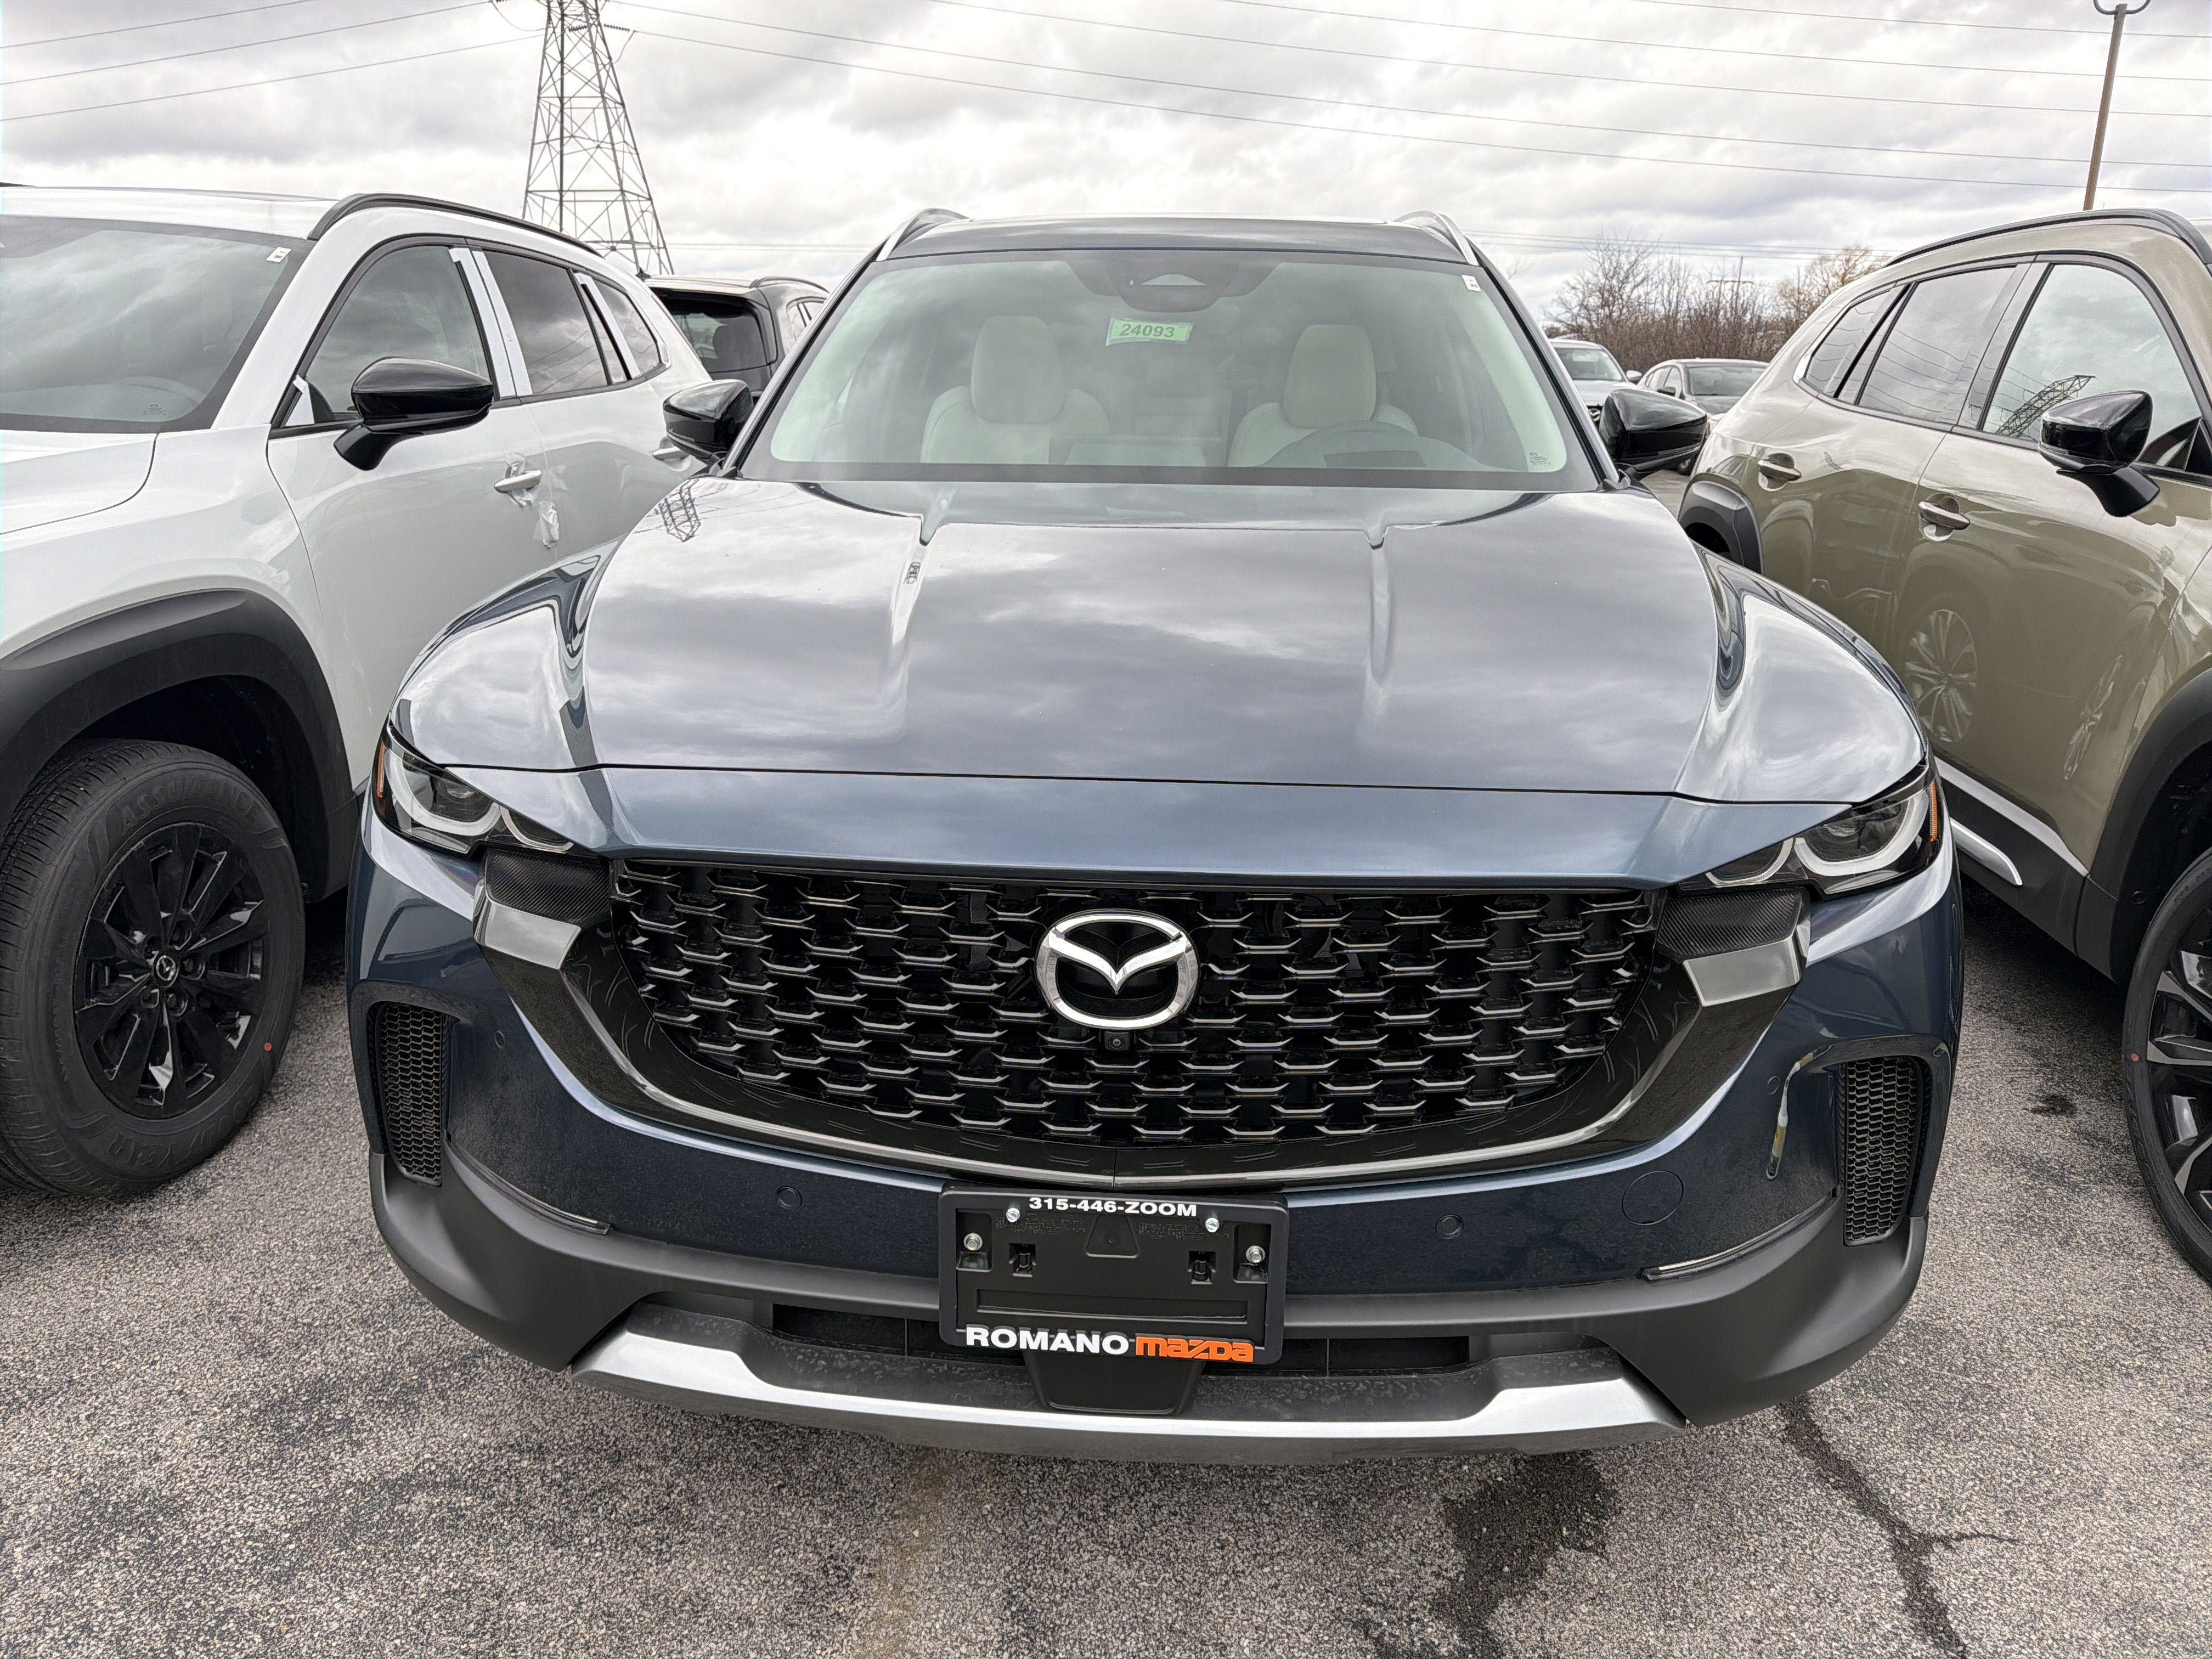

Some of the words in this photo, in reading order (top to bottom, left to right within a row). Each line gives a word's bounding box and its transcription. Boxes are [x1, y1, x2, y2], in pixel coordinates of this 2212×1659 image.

[1119, 324, 1175, 338] 24093
[1029, 1197, 1197, 1217] 315-446-ZOOM
[966, 1327, 1129, 1355] ROMANO
